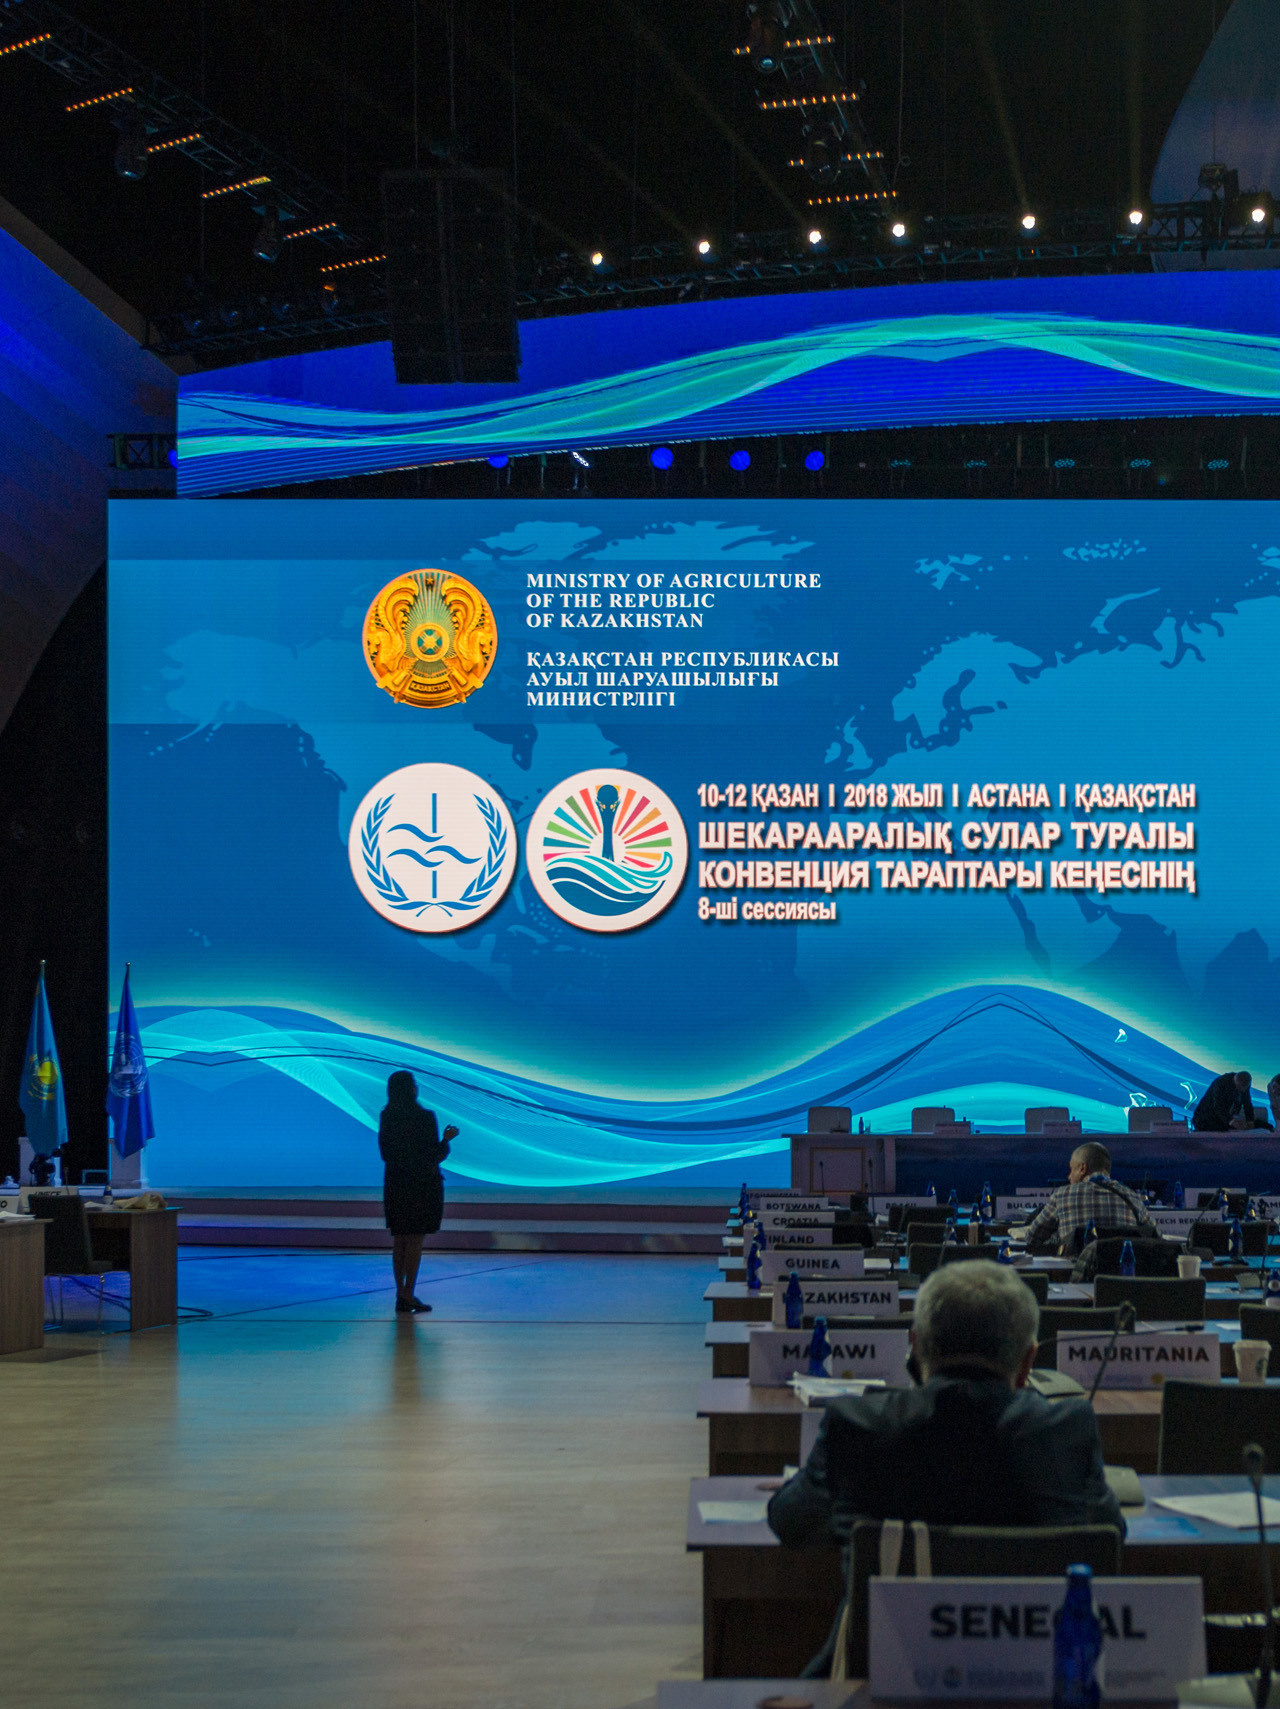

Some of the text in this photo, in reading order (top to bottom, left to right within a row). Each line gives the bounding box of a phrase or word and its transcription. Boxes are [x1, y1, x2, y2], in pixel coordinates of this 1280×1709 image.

[527, 573, 821, 588] MINISTRY OF AGRICULTURE
[526, 593, 715, 608] OF THE REPUBLIC
[526, 613, 704, 628] OF KAZAKHSTAN
[527, 651, 839, 669] ҚАЗАҚСТАН РЕСПУБЛИКАСЫ
[526, 672, 779, 687] АУЫЛ ШАРУАШЫЛЫҒЫ
[527, 691, 676, 706] МИНИСТРЛІГІ
[697, 783, 747, 807] 10-12
[751, 783, 819, 813] ҚАЗАН
[843, 783, 888, 807] 2018
[891, 783, 943, 807] ЖЫЛ
[967, 783, 1051, 807] АСТАНА
[1075, 783, 1196, 813] ҚАЗАҚСТАН
[698, 821, 1194, 854] ШЕКАРААРАЛЫҚ СУЛАР ТУРАЛЫ
[698, 860, 1196, 893] КОНВЕНЦИЯ ТАРАПТАРЫ КЕҢЕСІНІҢ
[698, 896, 836, 920] 8-ші сессиясы
[785, 1258, 840, 1269] GUINEA
[782, 1292, 891, 1304] ZAKHSTAN
[782, 1344, 876, 1359] MAAWI
[1068, 1346, 1210, 1362] MAURITANIA
[929, 1604, 1147, 1640] SENEAL
